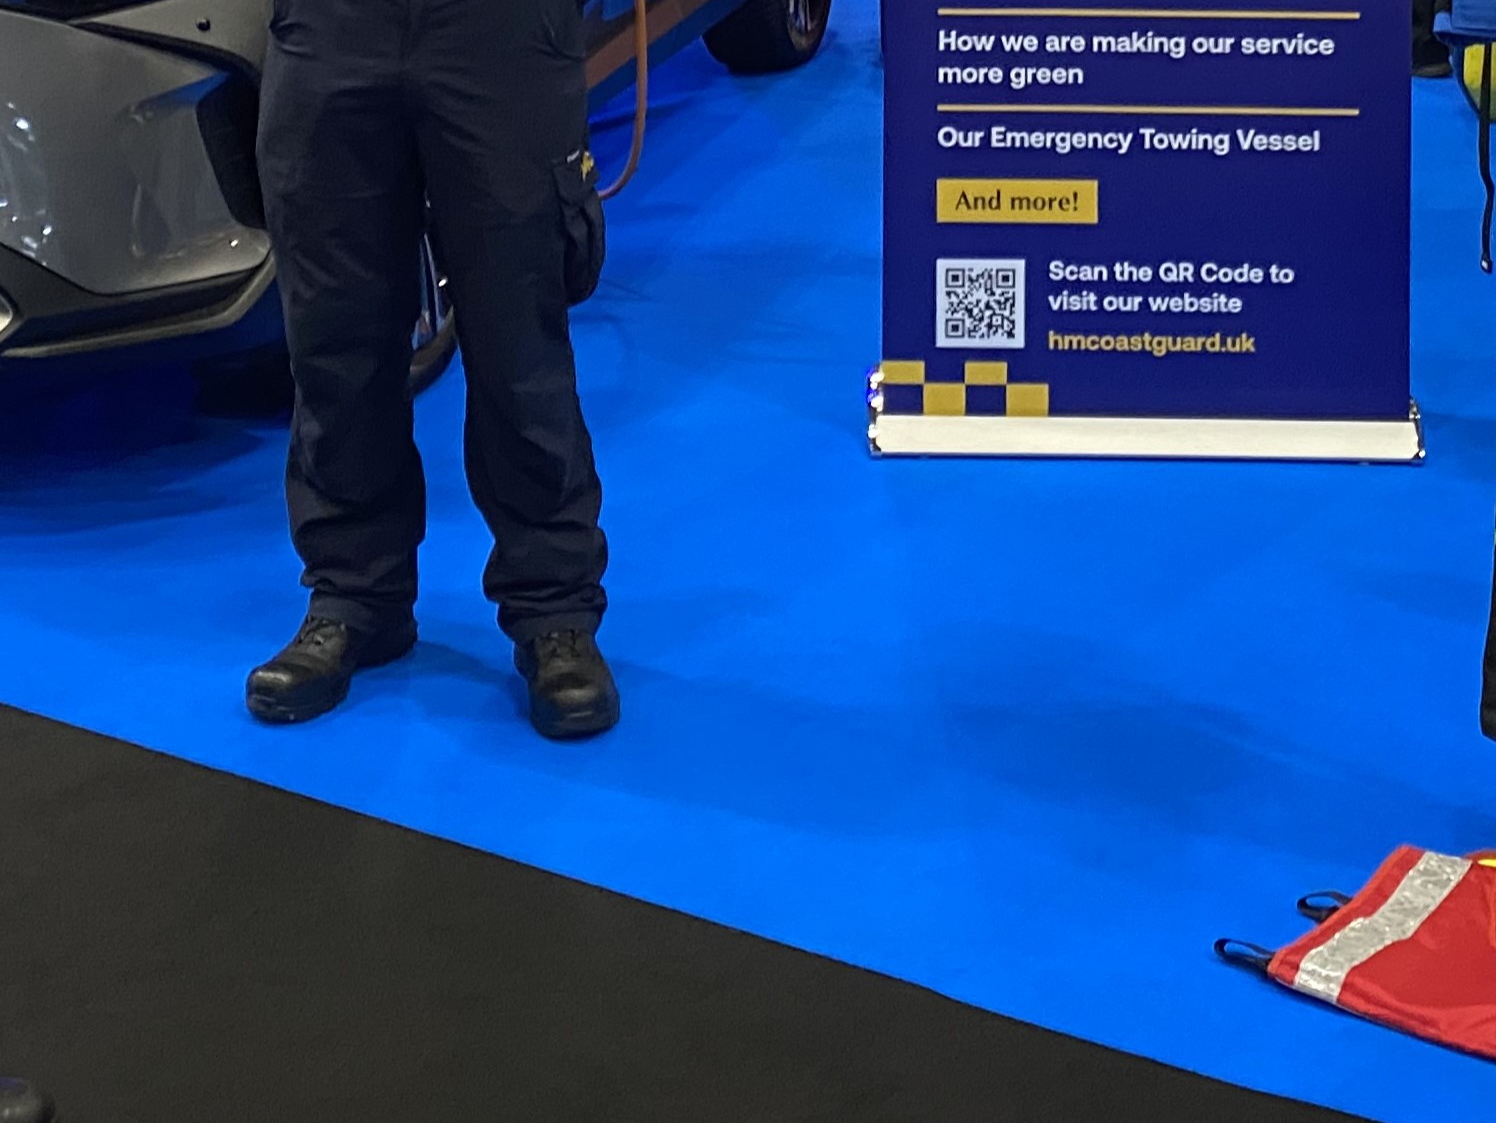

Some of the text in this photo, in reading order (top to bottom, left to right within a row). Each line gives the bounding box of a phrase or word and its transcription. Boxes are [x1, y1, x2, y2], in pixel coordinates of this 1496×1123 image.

[938, 31, 1335, 59] How we are making our service
[938, 67, 1084, 90] more green
[938, 127, 1321, 156] Our Emergency Towing Vessel
[955, 190, 1080, 212] And more!
[1048, 261, 1295, 284] Scan the QR Code to
[1048, 291, 1243, 313] visit our website
[1048, 331, 1256, 356] hmcoastguard.uk
